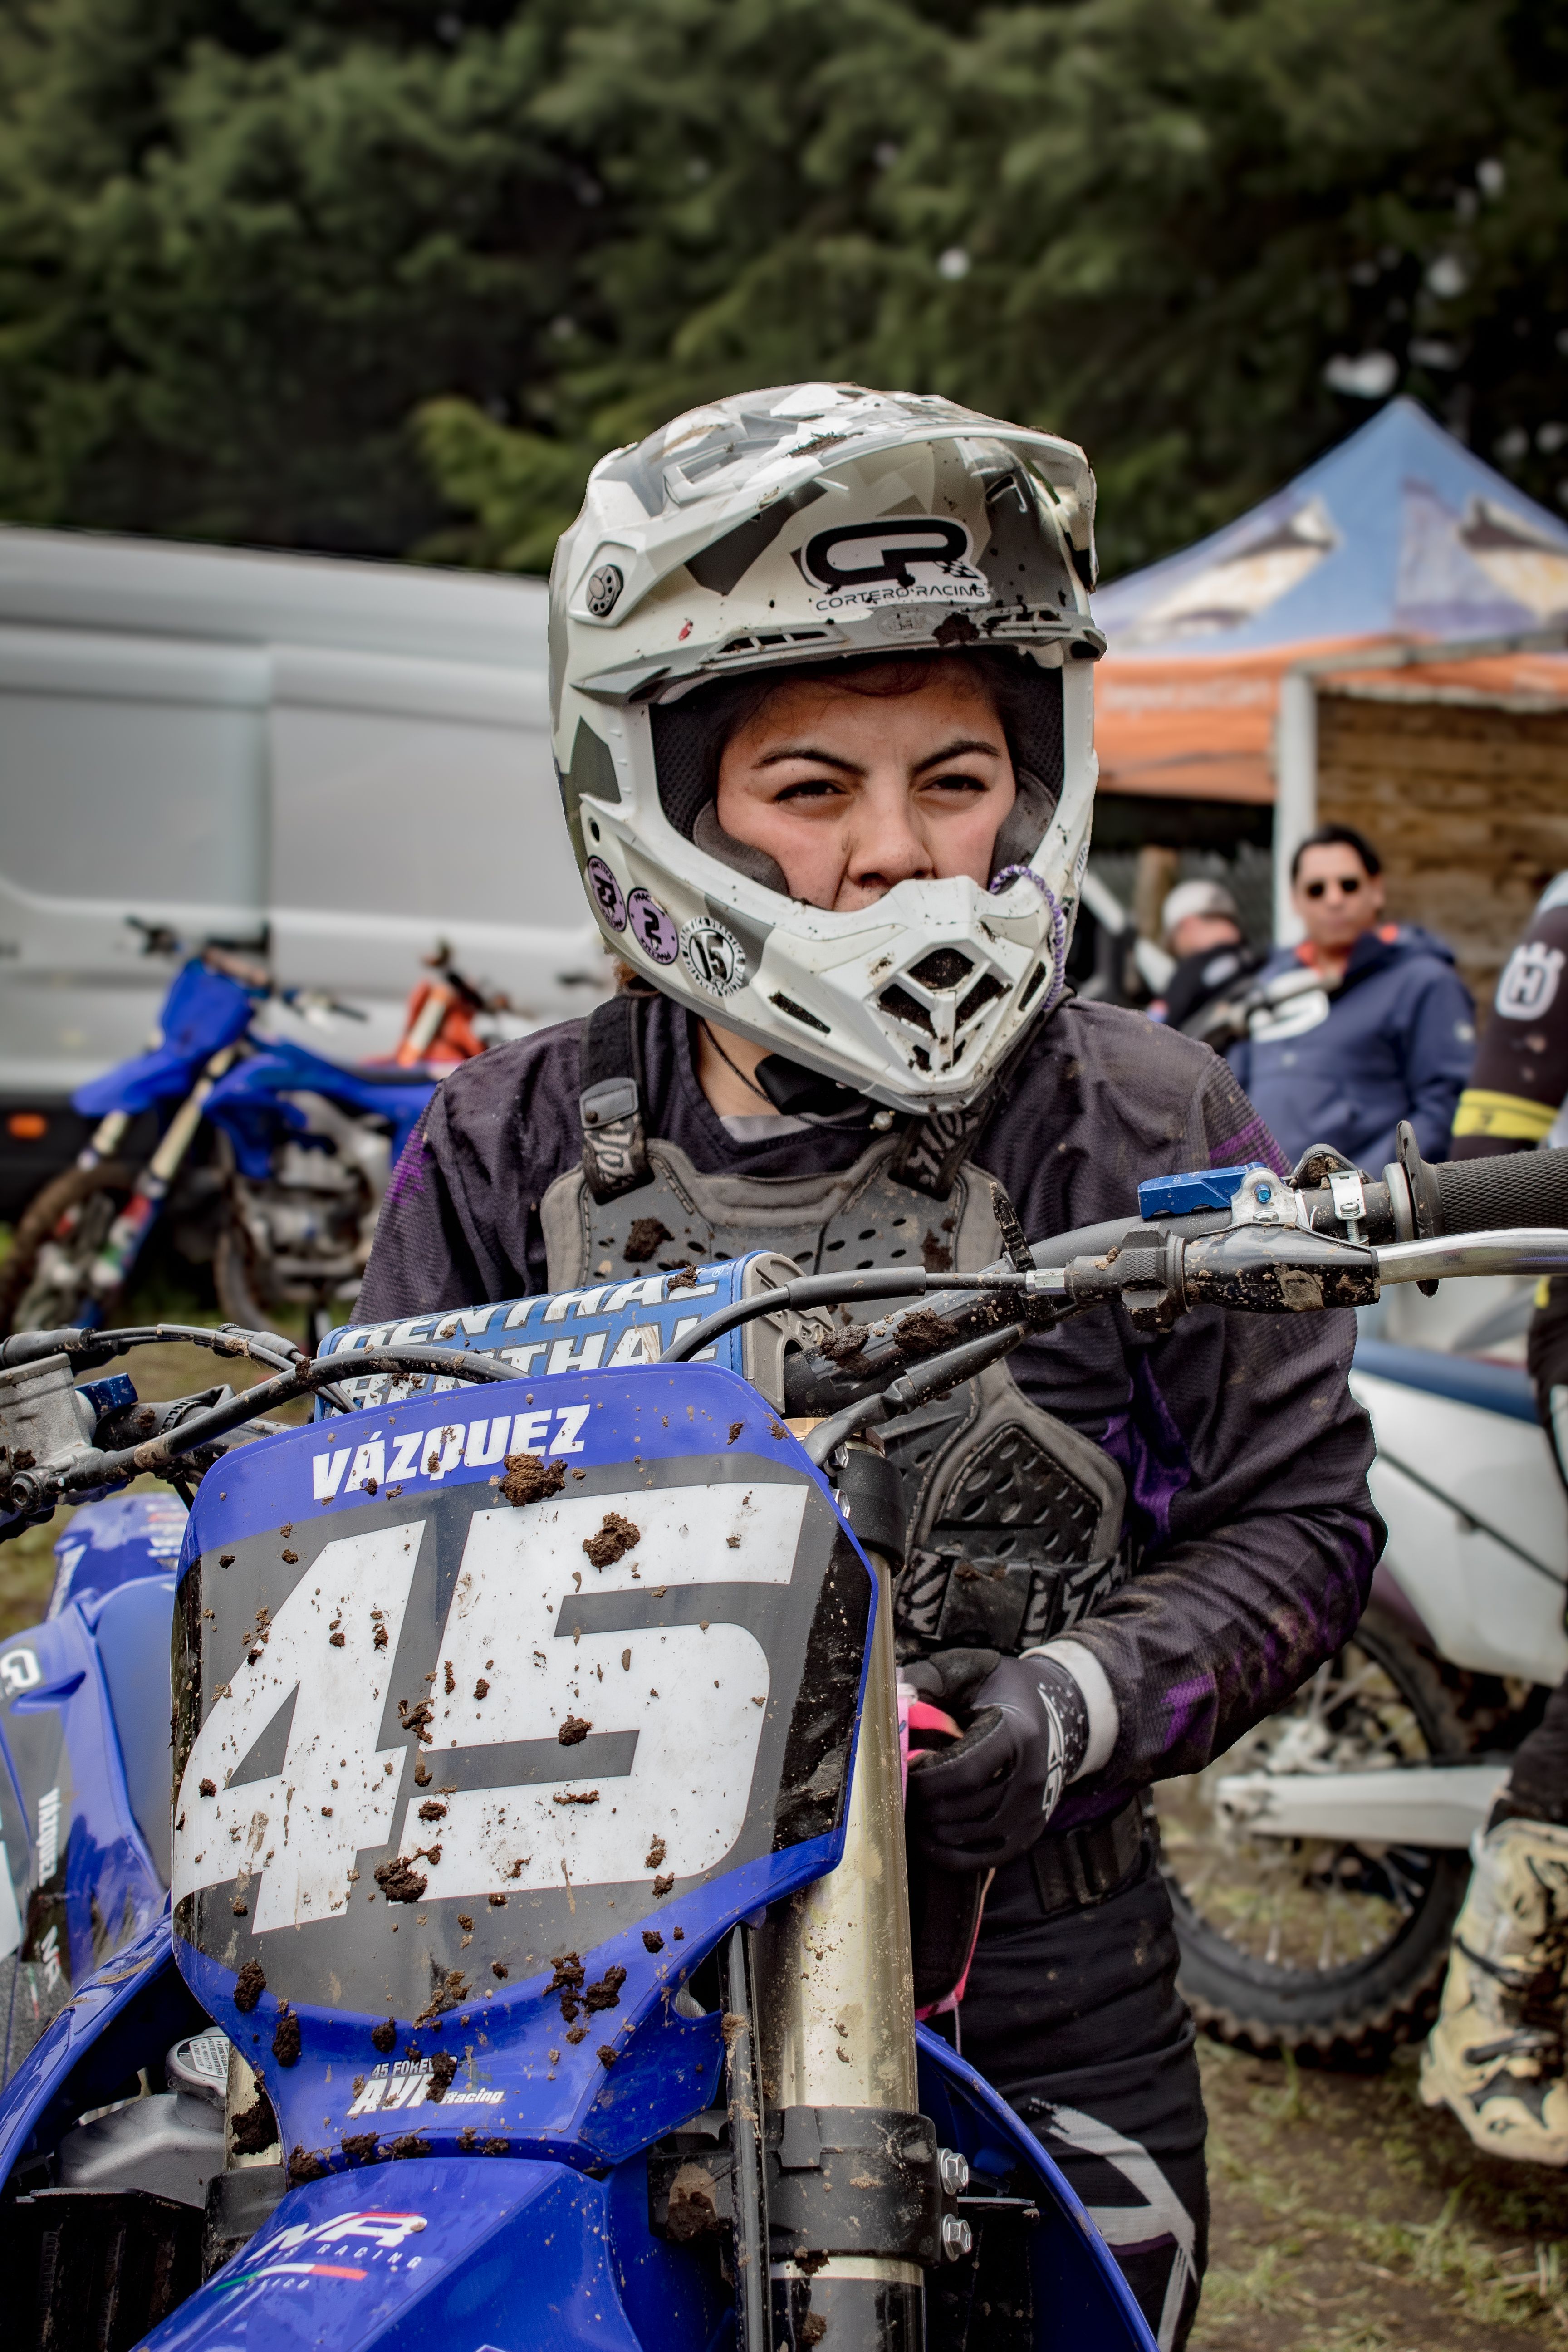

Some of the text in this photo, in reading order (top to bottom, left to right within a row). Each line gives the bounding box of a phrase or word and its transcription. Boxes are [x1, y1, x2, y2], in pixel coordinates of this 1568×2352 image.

[816, 586, 985, 611] CORTERO RACING
[313, 1404, 590, 1500] VÁZQUEZ
[172, 1483, 808, 1934] 45
[371, 2056, 457, 2078] 45 FORE
[440, 2087, 505, 2105] Racing
[316, 2244, 422, 2269] RACING
